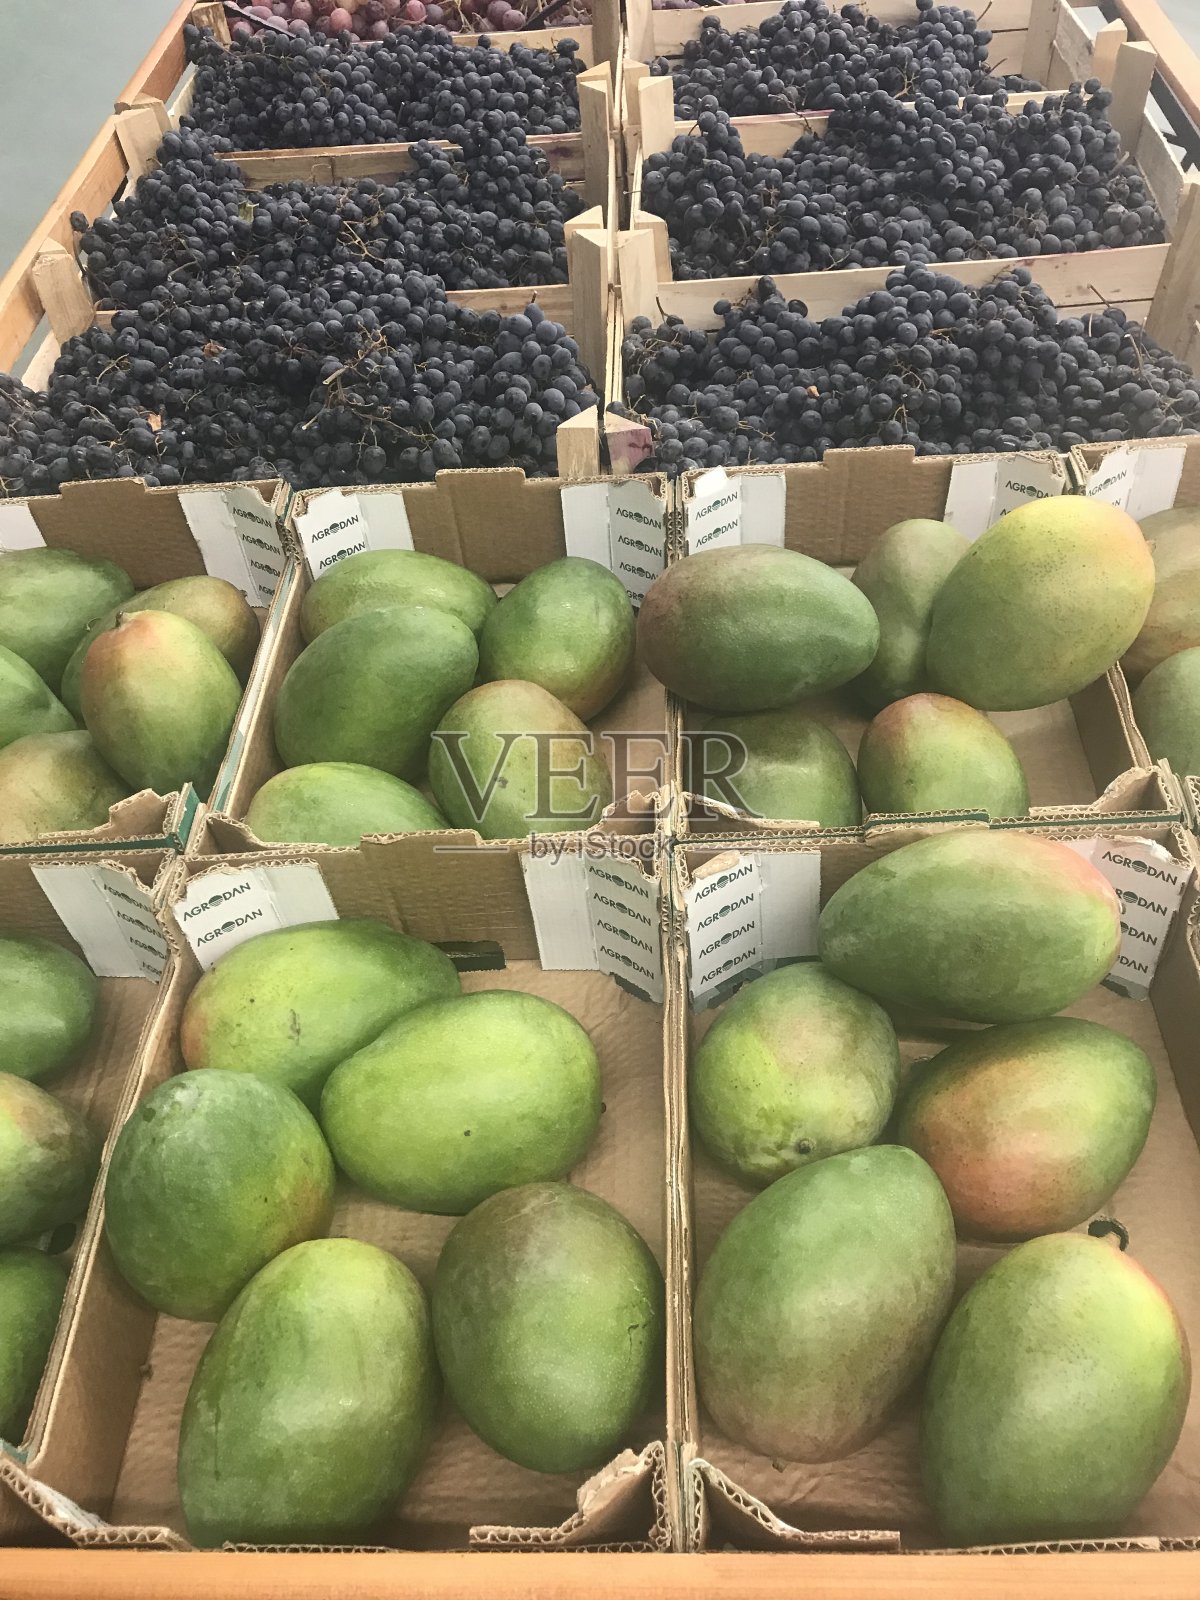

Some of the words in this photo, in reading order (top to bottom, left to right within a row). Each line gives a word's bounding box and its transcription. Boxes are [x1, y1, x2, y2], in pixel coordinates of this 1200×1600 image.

[233, 506, 272, 528] AGRODAN
[616, 508, 662, 530] AGRODAN
[695, 491, 738, 520] AGRODAN
[242, 533, 281, 556] AGRODAN
[312, 514, 359, 543] AGRODAN
[696, 519, 738, 548] AGRODAN
[320, 541, 366, 569] AGRODAN
[618, 535, 662, 557] AGRODAN
[619, 561, 659, 580] AGRODA
[589, 865, 649, 899] AGRODAN
[694, 863, 753, 903] AGRODAN
[1102, 850, 1178, 886] AGRODAN
[183, 882, 252, 922] AGRODAN
[593, 891, 651, 927] AGRODAN
[697, 892, 754, 932] AGRODAN
[1114, 887, 1168, 917] RODAN
[197, 908, 263, 947] AGRODAN
[596, 918, 653, 954] AGRODAN
[698, 920, 755, 960] AGRODAN
[600, 944, 655, 980] AGRODAN
[700, 947, 756, 985] AGRODAN
